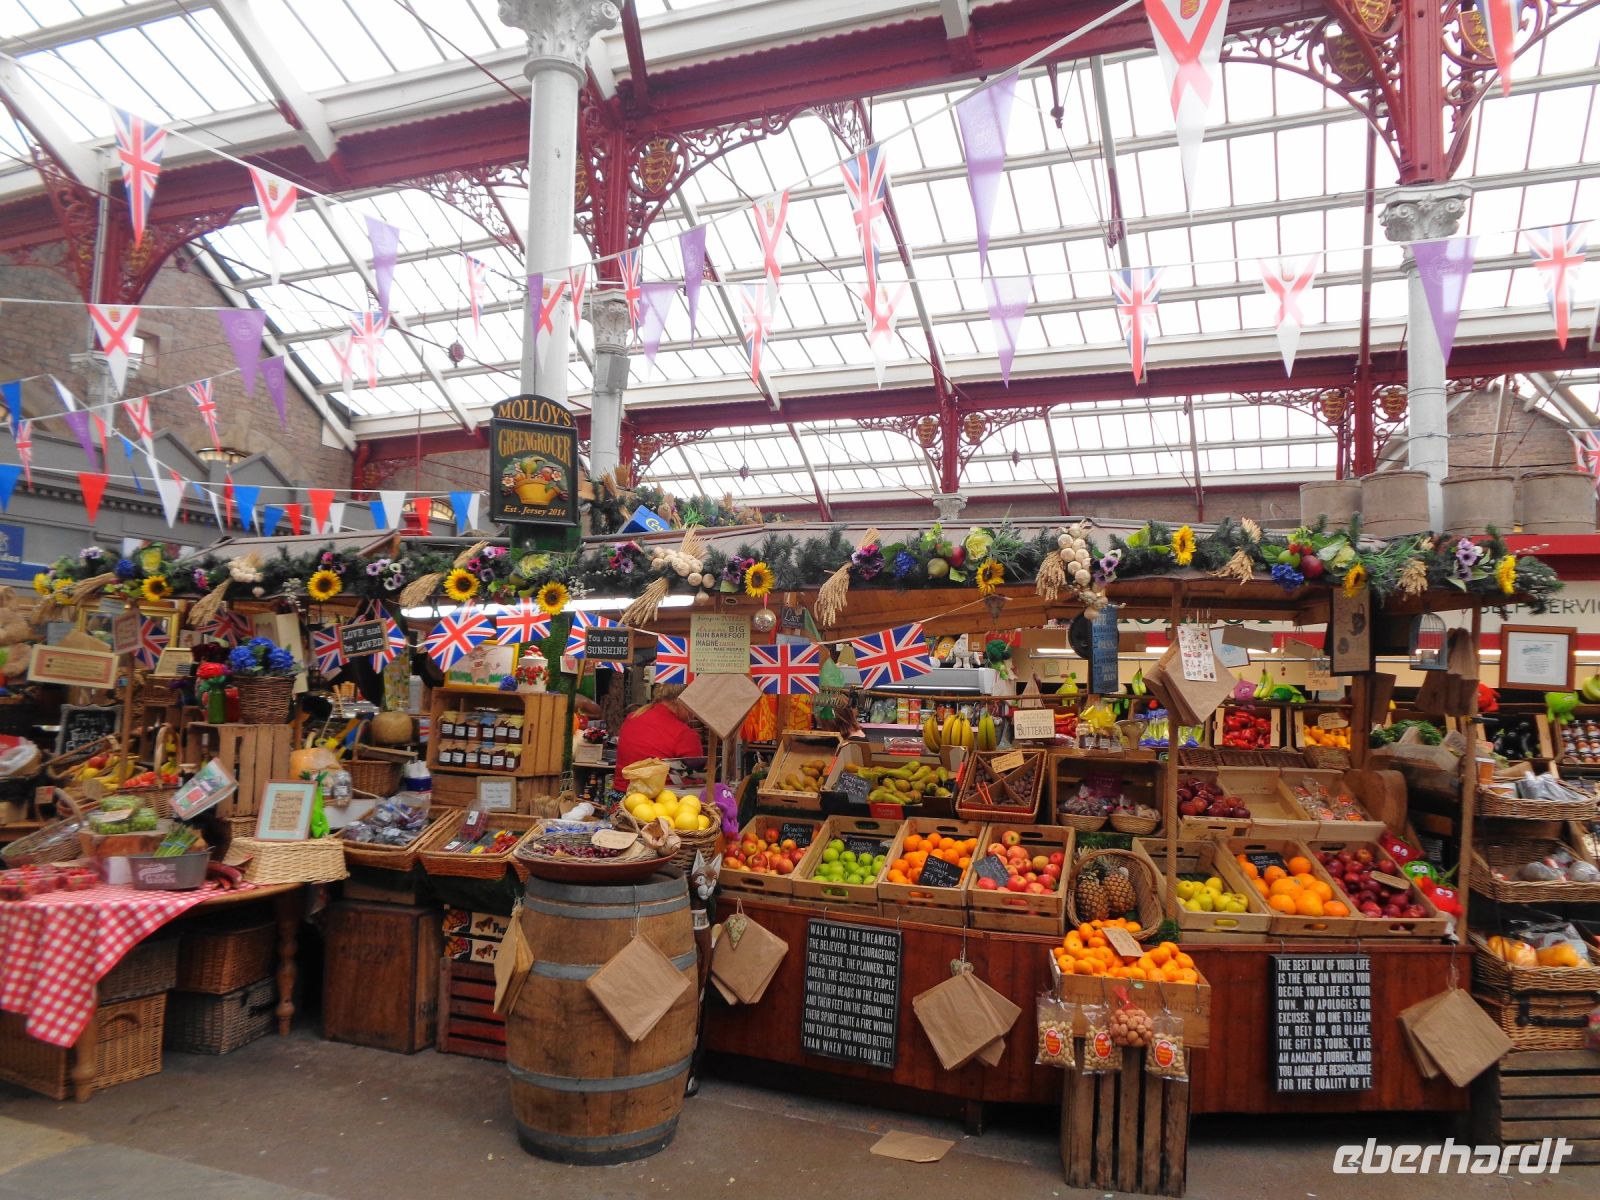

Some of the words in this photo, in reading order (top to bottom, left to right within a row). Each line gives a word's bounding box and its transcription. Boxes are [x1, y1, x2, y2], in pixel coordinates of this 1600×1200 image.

[497, 400, 571, 427] MOLLOY'S
[498, 429, 571, 467] GREENGROCER
[521, 506, 547, 516] Jersey
[547, 508, 566, 516] 2014
[343, 628, 364, 640] LOVE
[728, 625, 745, 633] BIG
[356, 637, 383, 650] LOVED
[618, 636, 628, 645] my
[927, 857, 949, 869] Small
[810, 924, 827, 936] WALK
[831, 928, 846, 939] WITH
[849, 930, 859, 942] THE
[810, 938, 819, 949] THE
[850, 945, 859, 955] THE
[809, 952, 818, 963] THE
[847, 958, 855, 969] THE
[886, 965, 896, 976] THE
[1279, 960, 1291, 970] THE
[1293, 960, 1310, 970] BEST
[1312, 960, 1324, 970] DAY
[1326, 960, 1335, 970] OF
[1337, 960, 1354, 970] YOUR
[1356, 960, 1370, 970] LIFE
[828, 970, 838, 981] THE
[839, 971, 872, 986] SUCCESSFUL
[874, 978, 895, 990] PEOPLE
[1278, 973, 1285, 984] IS
[1288, 973, 1301, 984] THE
[1303, 973, 1316, 984] ONE
[1319, 973, 1329, 984] ON
[1331, 973, 1354, 984] WHICH
[1357, 973, 1370, 984] YOU
[807, 980, 821, 992] WITH
[822, 983, 836, 994] THEIR
[838, 985, 854, 998] HEADS
[856, 989, 861, 998] IN
[863, 990, 872, 1001] THE
[874, 992, 894, 1005] CLOUDS
[1279, 986, 1304, 997] DECIDE
[1306, 986, 1324, 997] YOUR
[1327, 986, 1340, 997] LIFE
[1342, 986, 1349, 997] IS
[1352, 986, 1370, 997] YOUR
[806, 995, 816, 1005] AND
[818, 996, 832, 1008] THEIR
[832, 999, 843, 1010] FEET
[844, 1001, 850, 1011] ON
[852, 1002, 861, 1014] THE
[885, 1009, 893, 1019] LET
[1304, 999, 1314, 1010] NO
[1317, 999, 1358, 1010] APOLOGIES
[1361, 999, 1370, 1010] OR
[806, 1009, 820, 1020] THEIR
[821, 1011, 837, 1023] SPIRIT
[838, 1014, 854, 1027] IGNITE
[856, 1018, 859, 1027] A
[861, 1018, 872, 1030] FIRE
[874, 1021, 893, 1034] WITHIN
[1316, 1012, 1326, 1023] NO
[1328, 1012, 1341, 1023] ONE
[1344, 1012, 1352, 1023] TO
[1354, 1012, 1371, 1023] LEAN
[805, 1022, 815, 1033] YOU
[816, 1024, 822, 1034] TO
[824, 1025, 838, 1038] LEAVE
[840, 1028, 852, 1040] THIS
[853, 1031, 872, 1044] WORLD
[873, 1035, 892, 1048] BETTER
[1295, 1025, 1312, 1036] RELY
[1332, 1025, 1341, 1036] OR
[804, 1036, 820, 1049] THAN
[823, 1040, 841, 1054] WHEN
[845, 1044, 856, 1056] YOU
[859, 1047, 881, 1062] FOUND
[1279, 1038, 1292, 1049] THE
[1295, 1038, 1311, 1049] GIFT
[1314, 1038, 1321, 1049] IS
[1354, 1038, 1360, 1049] IT
[1363, 1038, 1371, 1049] IS
[1279, 1052, 1289, 1063] AN
[1291, 1052, 1322, 1063] AMAZING
[1357, 1052, 1371, 1063] AND
[1279, 1064, 1292, 1076] YOU
[1294, 1064, 1314, 1076] ALONE
[1315, 1064, 1328, 1076] ARE
[1329, 1064, 1372, 1076] RESPONSIBLE
[1279, 1078, 1294, 1090] FOR
[1297, 1078, 1311, 1090] THE
[1315, 1078, 1347, 1090] QUALITY
[1350, 1078, 1359, 1090] OF
